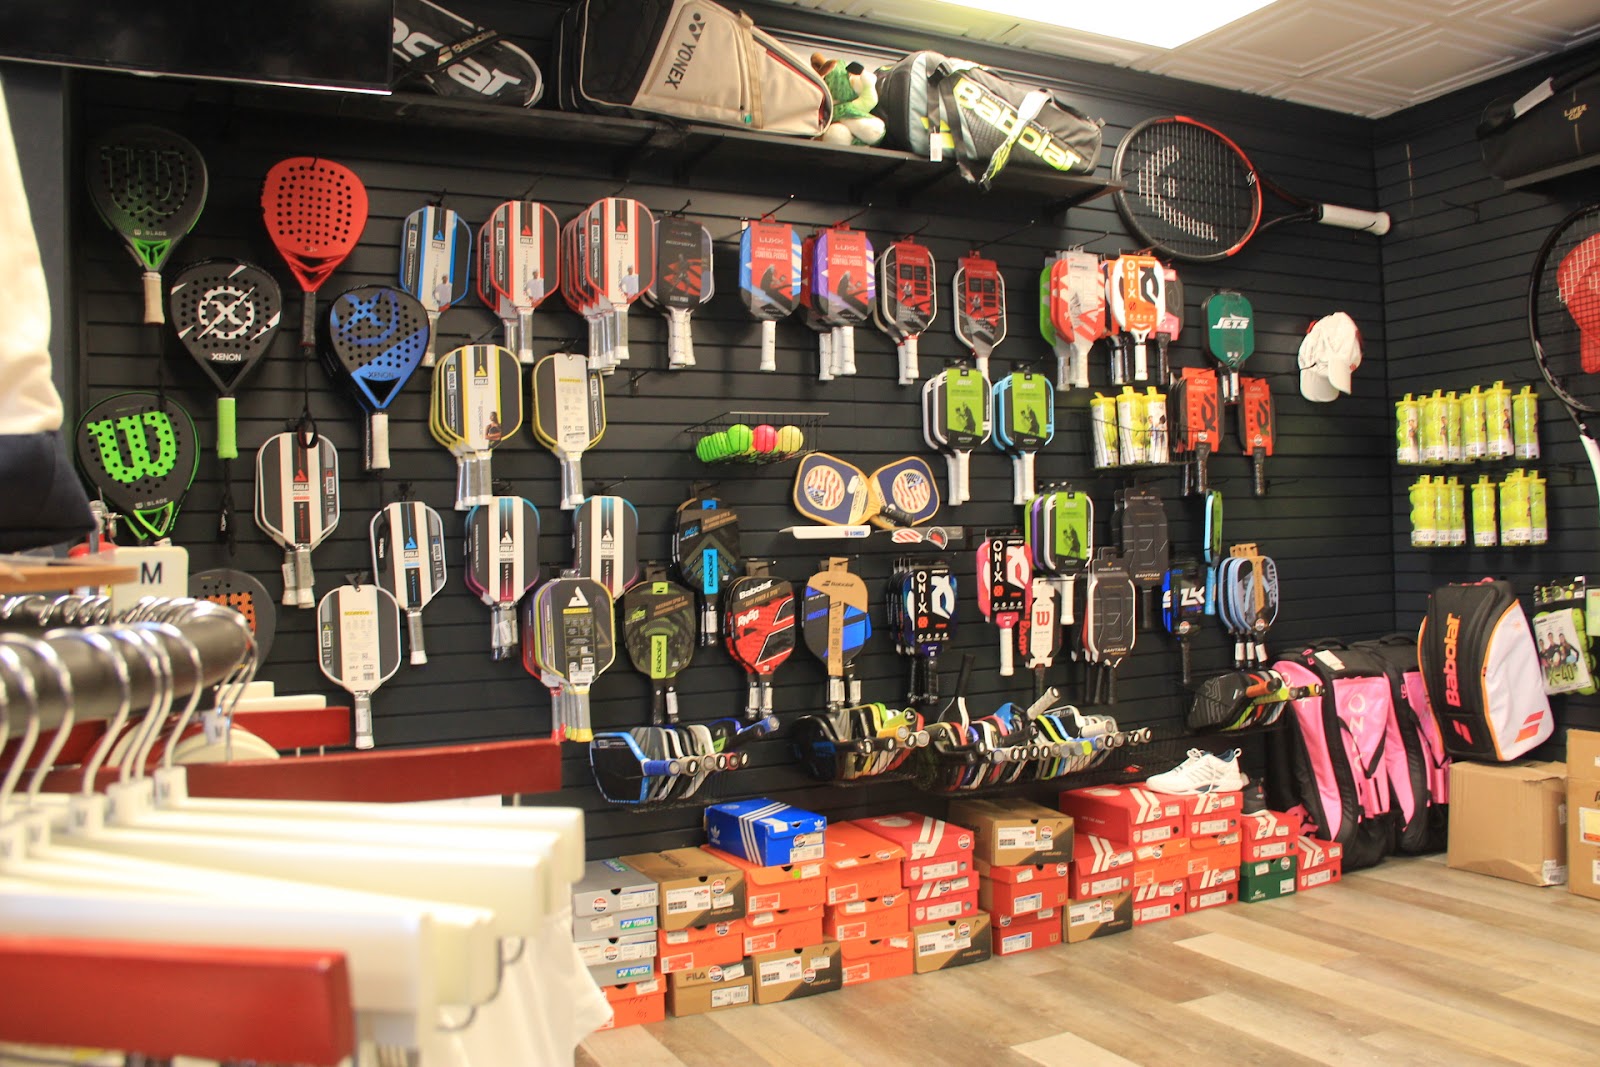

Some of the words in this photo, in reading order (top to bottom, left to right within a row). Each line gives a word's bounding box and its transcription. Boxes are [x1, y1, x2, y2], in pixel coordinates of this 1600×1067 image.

[664, 42, 697, 90] YONEX
[1126, 259, 1137, 298] ONIX
[1212, 313, 1250, 330] JETS
[211, 352, 242, 361] XENON
[368, 371, 395, 379] XENON
[146, 498, 168, 507] BLADE
[993, 540, 1004, 582] ONIX
[140, 561, 163, 584] M
[739, 580, 773, 600] Babolat
[916, 571, 929, 614] ONIX
[1443, 612, 1462, 707] Babolat
[633, 917, 653, 926] YONEX
[628, 966, 649, 976] YONEX
[686, 972, 706, 981] FILA
